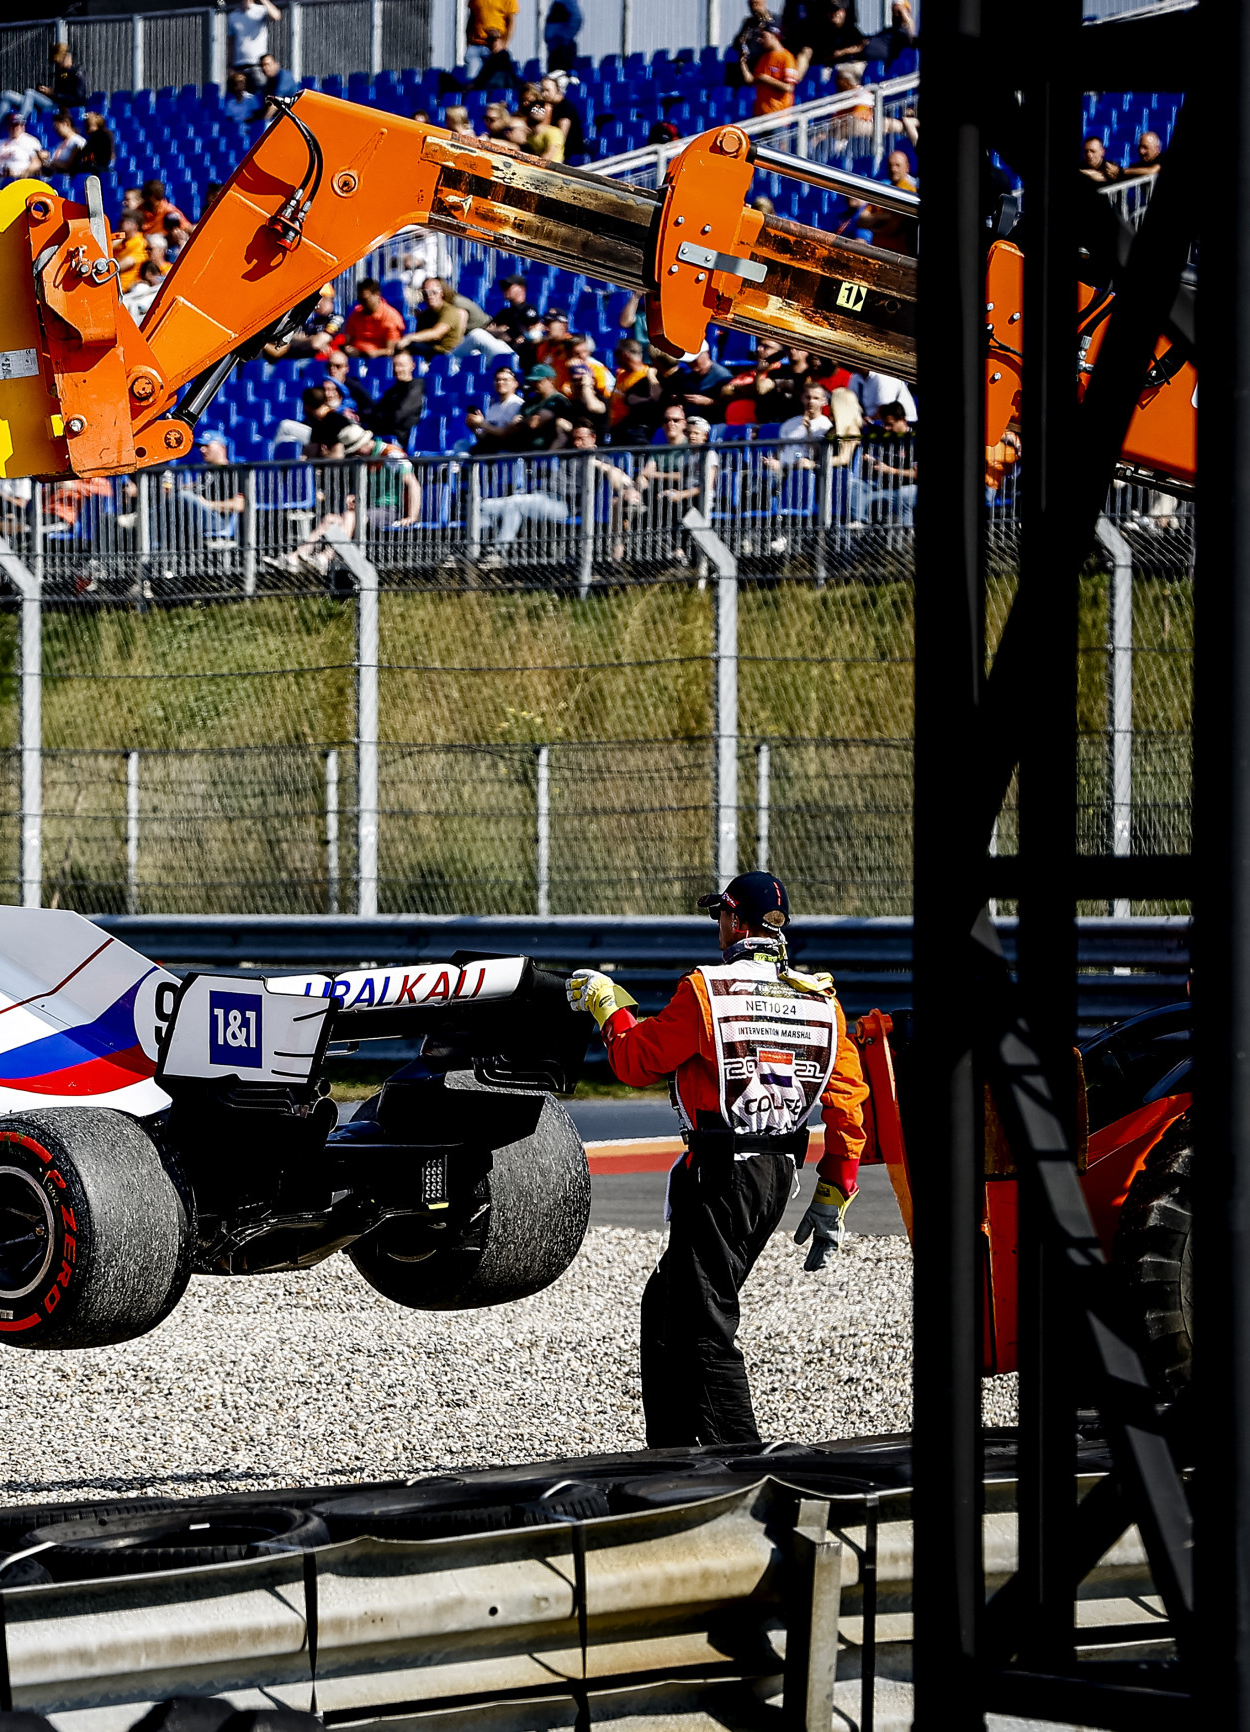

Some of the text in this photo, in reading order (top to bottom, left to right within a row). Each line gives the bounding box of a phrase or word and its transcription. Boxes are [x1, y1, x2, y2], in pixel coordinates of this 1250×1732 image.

[214, 1008, 256, 1048] 1&1
[781, 1030, 811, 1040] MARSHAL
[45, 1169, 67, 1189] P
[44, 1204, 77, 1314] ZERO
